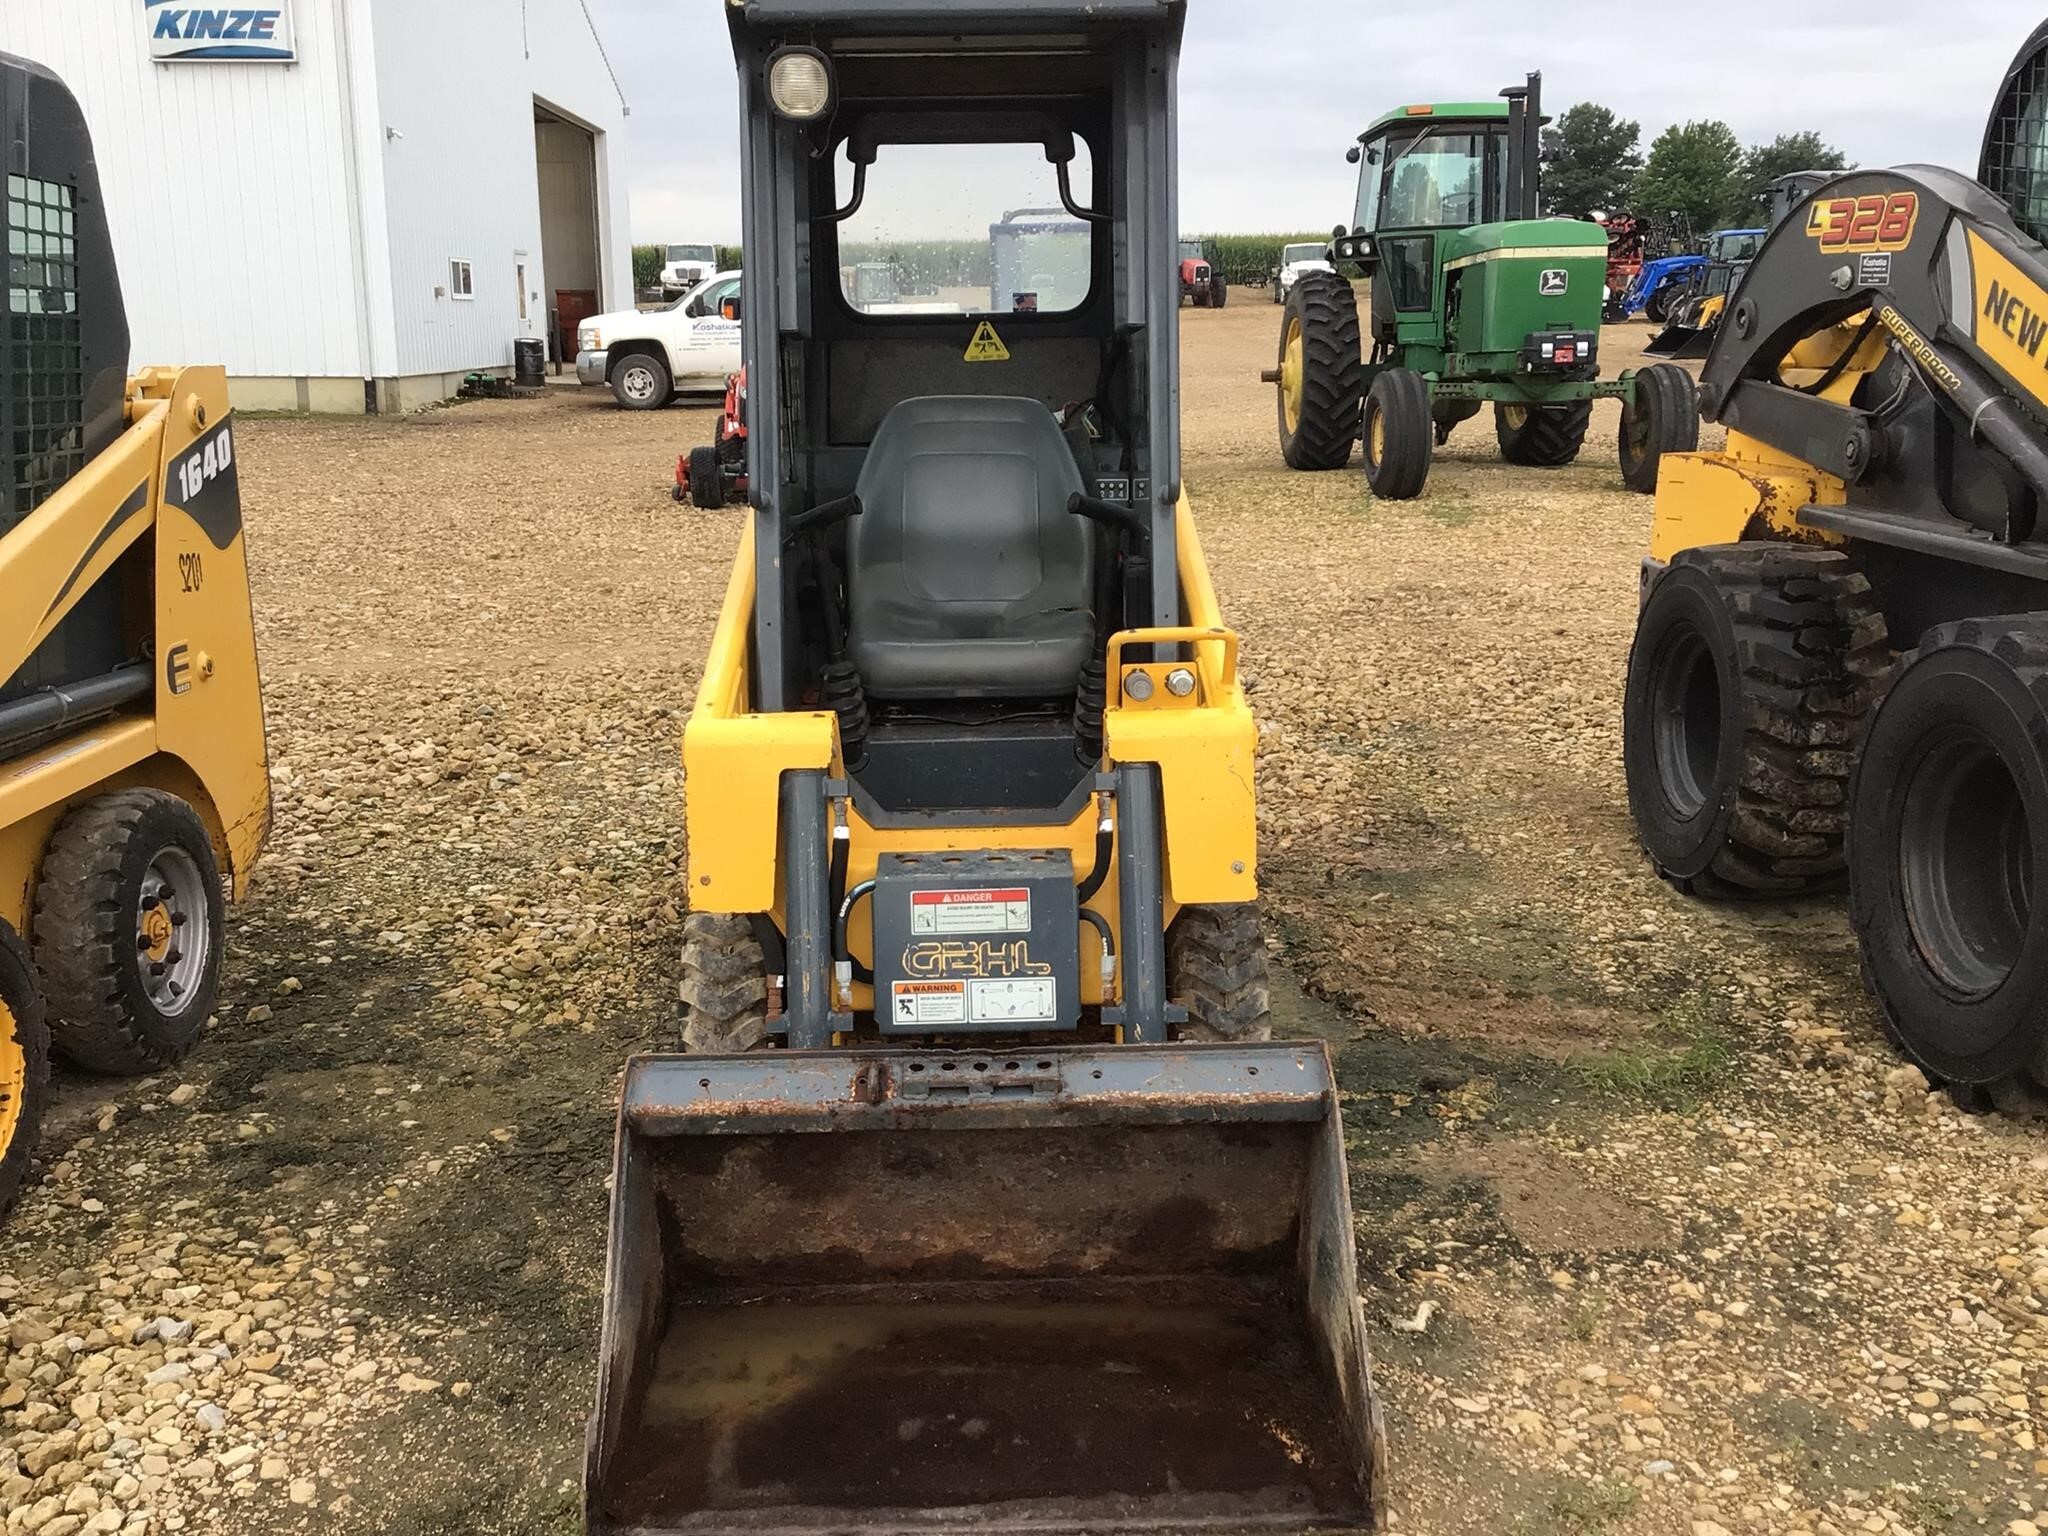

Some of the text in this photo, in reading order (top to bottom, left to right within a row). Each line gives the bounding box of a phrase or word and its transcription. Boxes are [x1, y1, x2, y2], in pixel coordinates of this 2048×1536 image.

[152, 10, 281, 39] KINZE
[1807, 193, 1917, 251] L328
[1983, 279, 2047, 358] NEW
[178, 428, 232, 503] 1640
[953, 893, 993, 902] DANGER
[902, 940, 1051, 977] GEHL
[912, 984, 957, 992] WARNING
